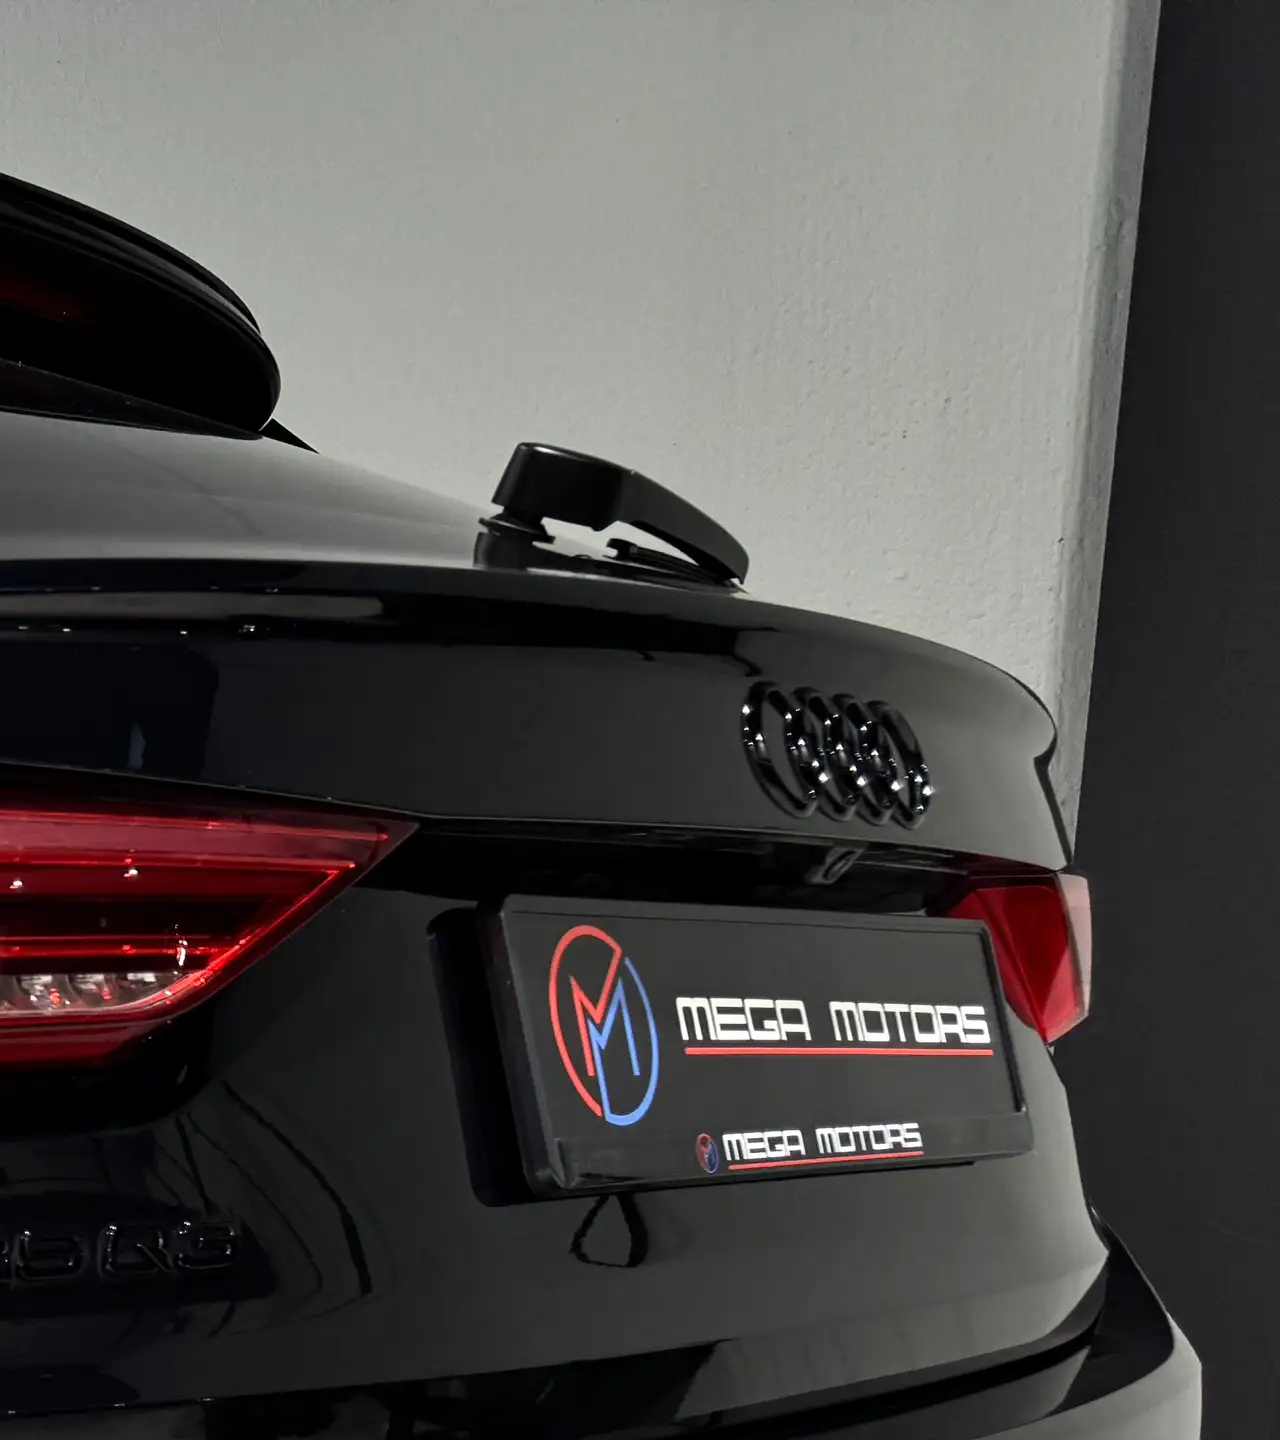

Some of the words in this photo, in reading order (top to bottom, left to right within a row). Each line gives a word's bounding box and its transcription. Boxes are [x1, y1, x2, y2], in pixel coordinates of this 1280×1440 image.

[675, 996, 812, 1041] MEGA
[828, 1001, 991, 1044] MOTORS
[721, 1129, 807, 1162] MEGA
[814, 1122, 924, 1155] MOTORS
